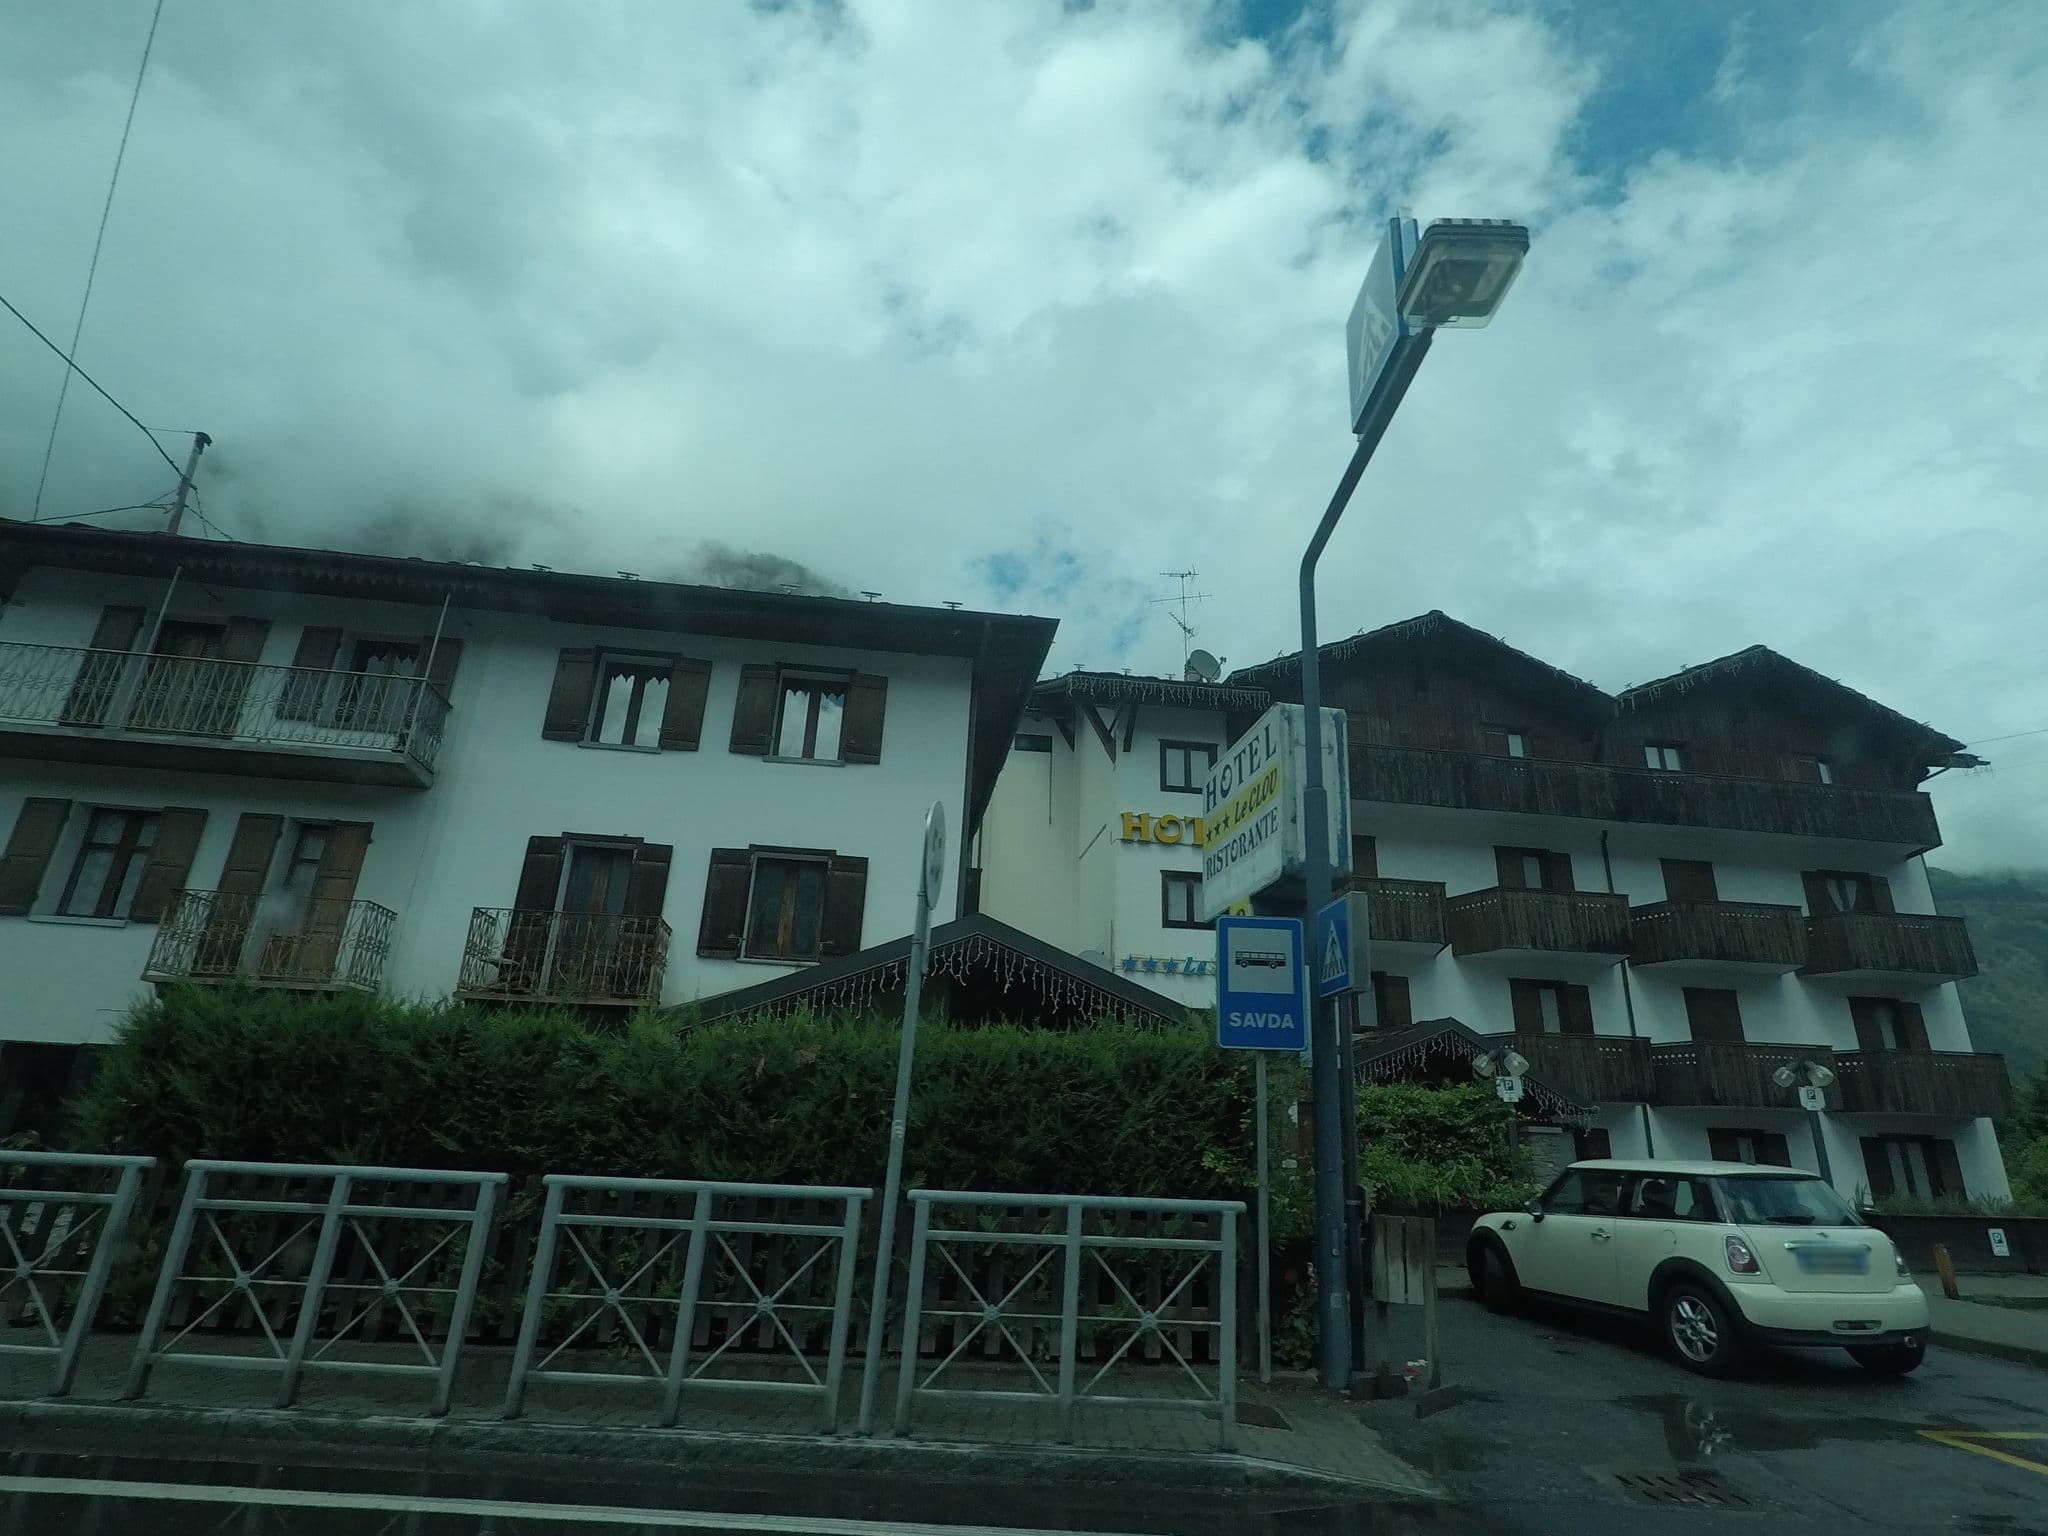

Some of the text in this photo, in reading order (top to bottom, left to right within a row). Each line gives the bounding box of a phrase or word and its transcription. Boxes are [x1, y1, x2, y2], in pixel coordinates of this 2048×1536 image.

[1204, 723, 1277, 815] HOTEL
[1206, 806, 1279, 881] RISTORANTE
[1229, 1012, 1295, 1029] SAVDA
